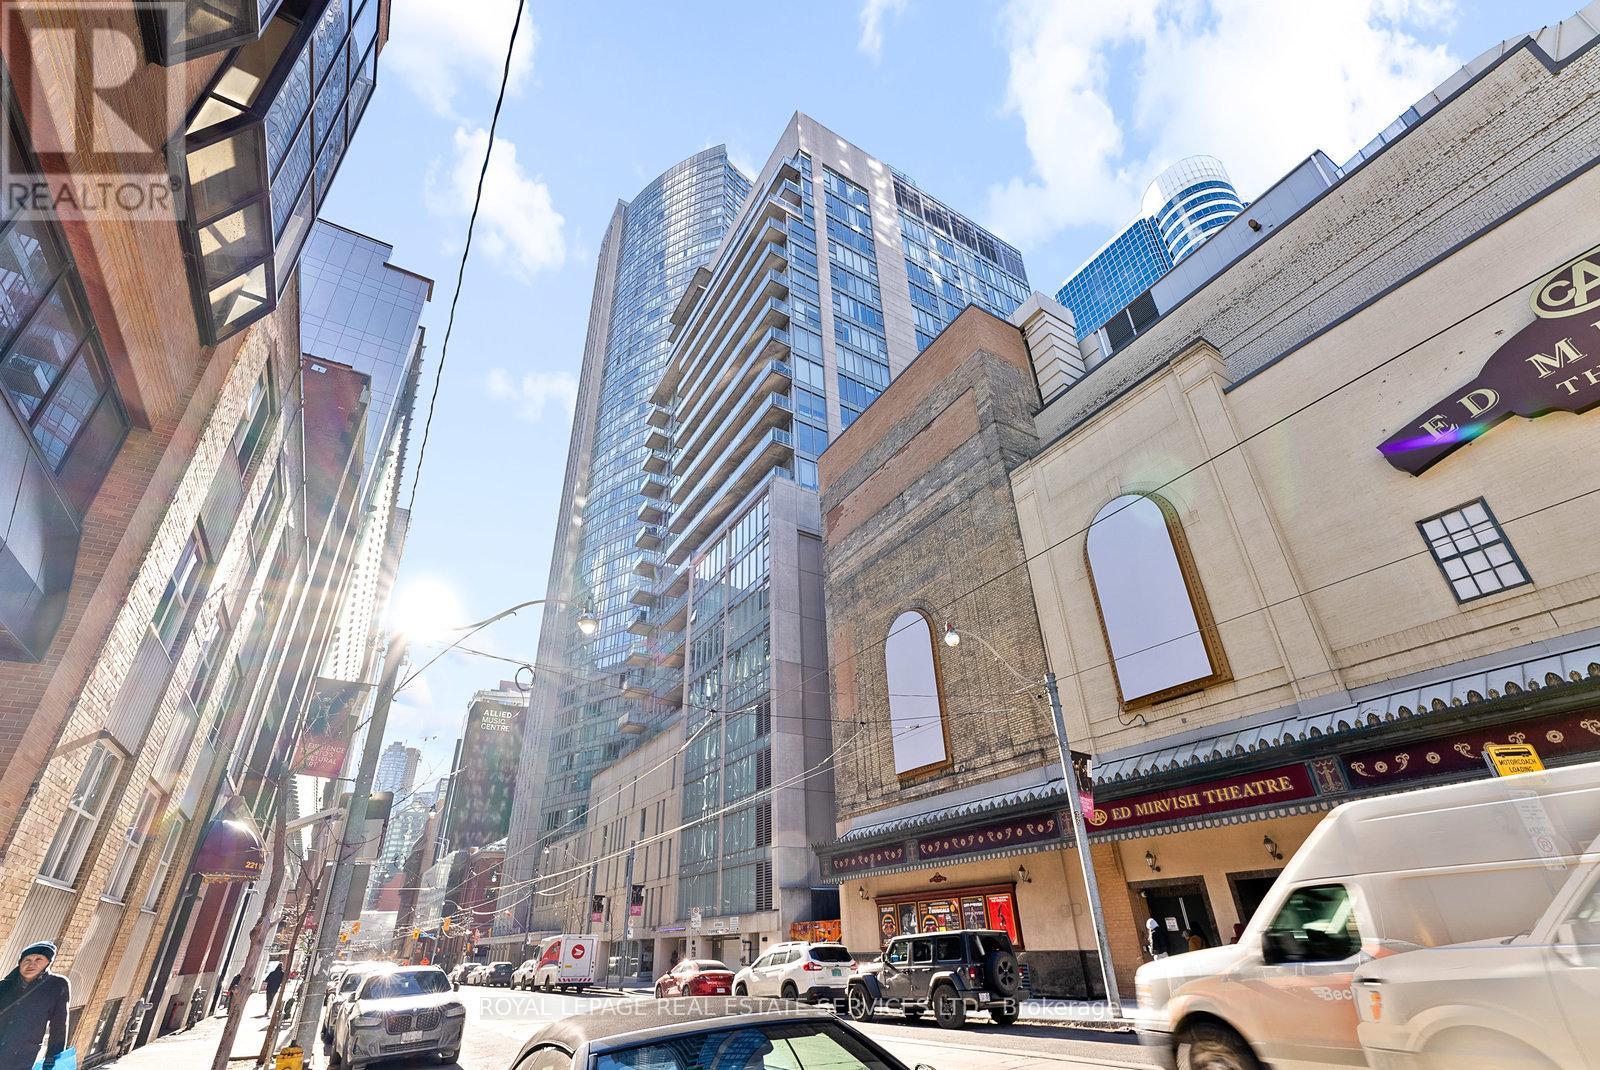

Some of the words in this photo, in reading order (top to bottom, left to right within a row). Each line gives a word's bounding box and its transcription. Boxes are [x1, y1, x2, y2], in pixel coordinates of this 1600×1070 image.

[1419, 388, 1500, 443] ED
[483, 709, 512, 718] ALLIED
[481, 717, 506, 725] MUSIC
[480, 723, 510, 732] CENTRE
[1498, 758, 1537, 766] MOTORCOACH
[1509, 765, 1535, 773] LOADING
[1112, 806, 1131, 821] ED
[1135, 793, 1201, 816] MIRVISH
[1203, 776, 1294, 805] THEATRE
